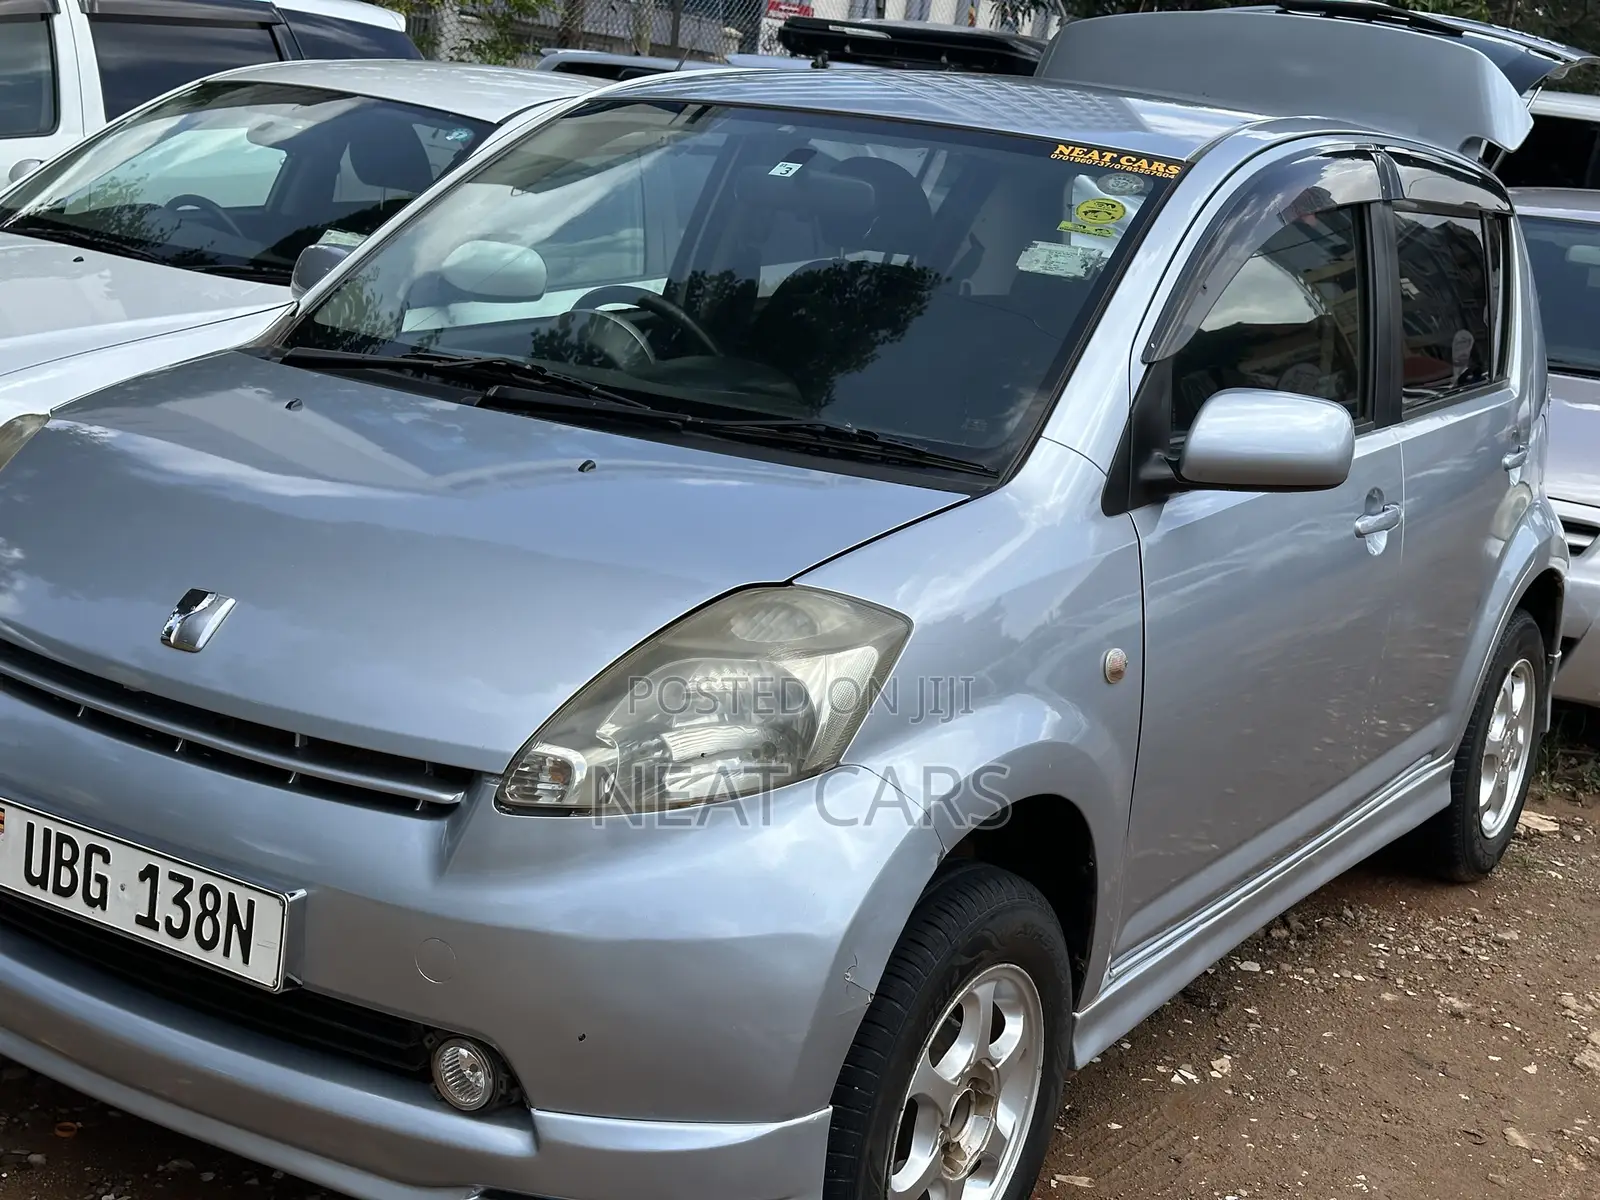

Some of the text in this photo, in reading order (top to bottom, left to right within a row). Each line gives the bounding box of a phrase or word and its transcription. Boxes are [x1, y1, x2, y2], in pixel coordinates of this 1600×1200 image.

[780, 167, 792, 175] 3
[1053, 144, 1182, 175] NEAT CARS
[24, 821, 256, 966] UBG 138N
